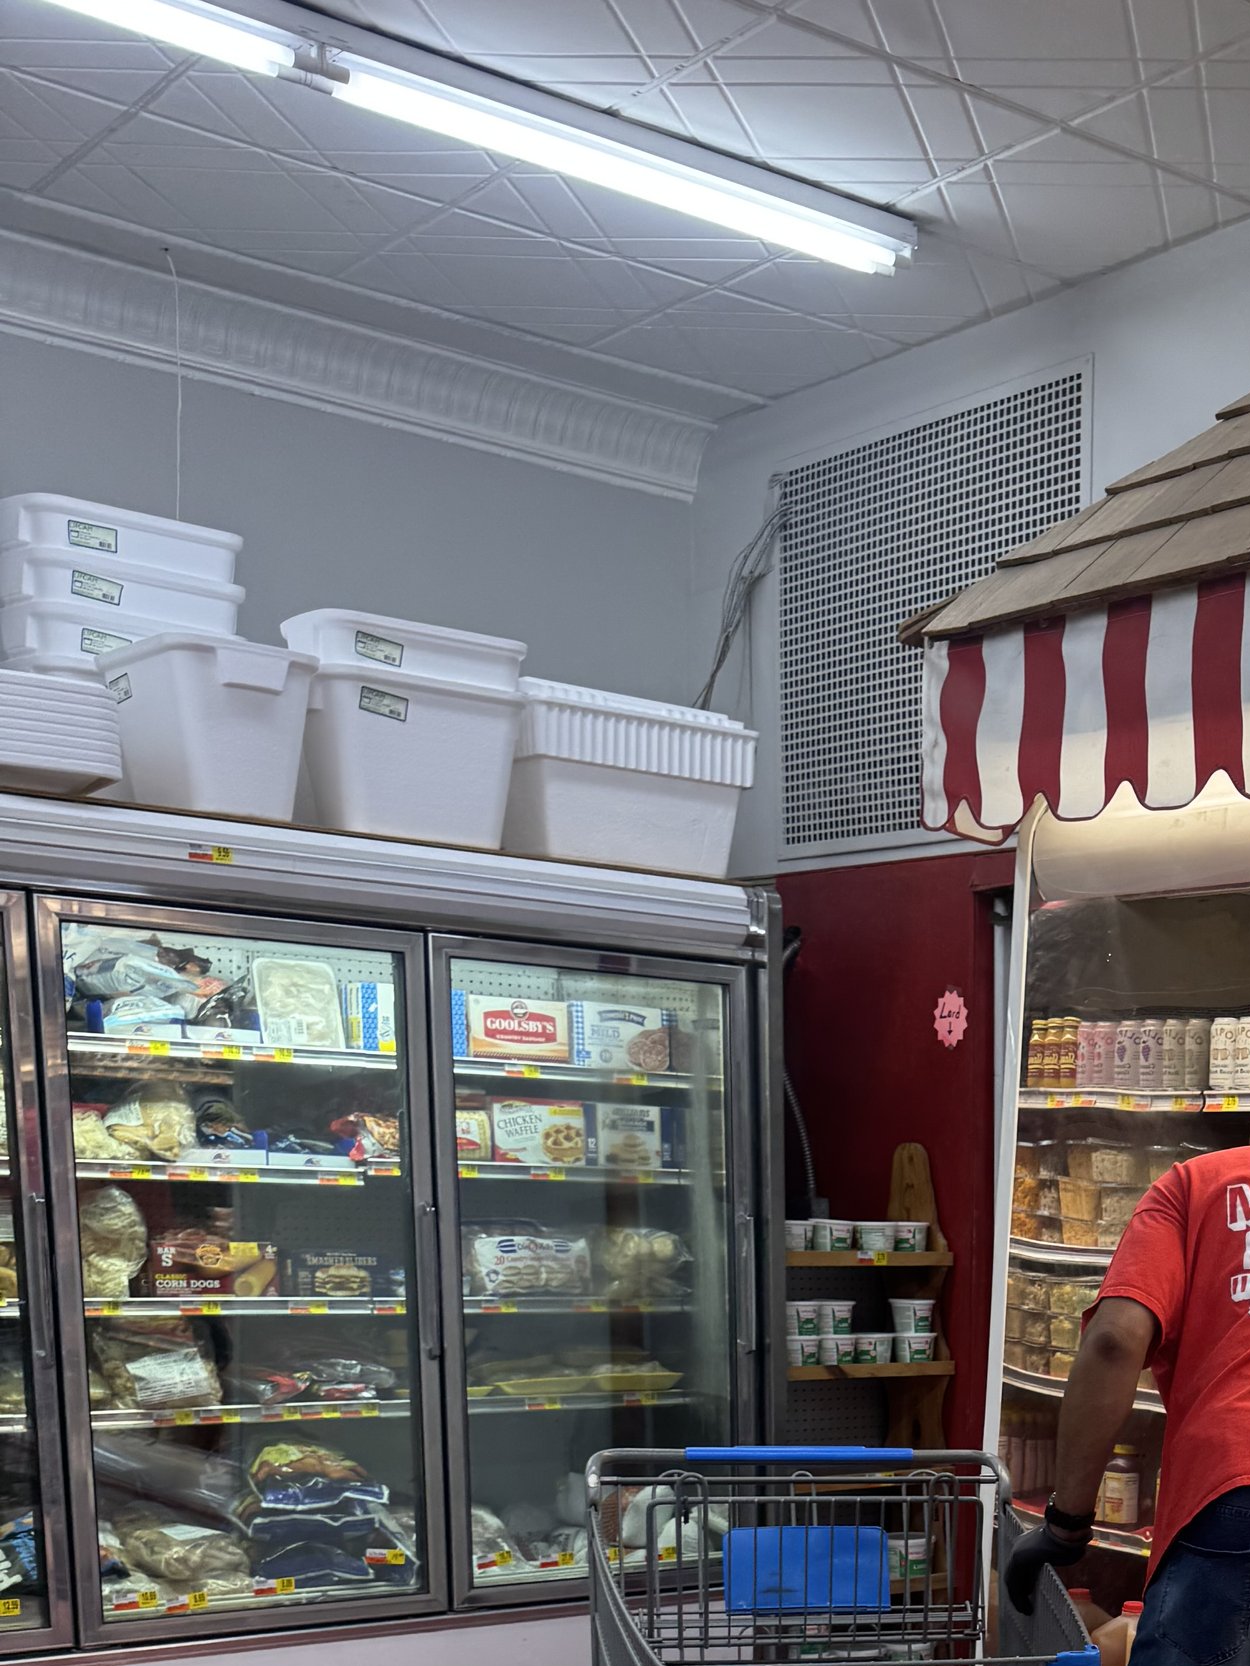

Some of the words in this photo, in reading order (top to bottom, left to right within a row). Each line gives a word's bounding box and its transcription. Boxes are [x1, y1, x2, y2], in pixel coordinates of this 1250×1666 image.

[486, 1018, 555, 1034] GOOLSBY'S
[496, 1114, 543, 1129] CHICKEN
[505, 1125, 540, 1138] WAFFLE
[162, 1254, 173, 1267] S
[155, 1273, 187, 1281] CLASSIC
[155, 1280, 187, 1289] CORN
[190, 1280, 221, 1289] DOGS
